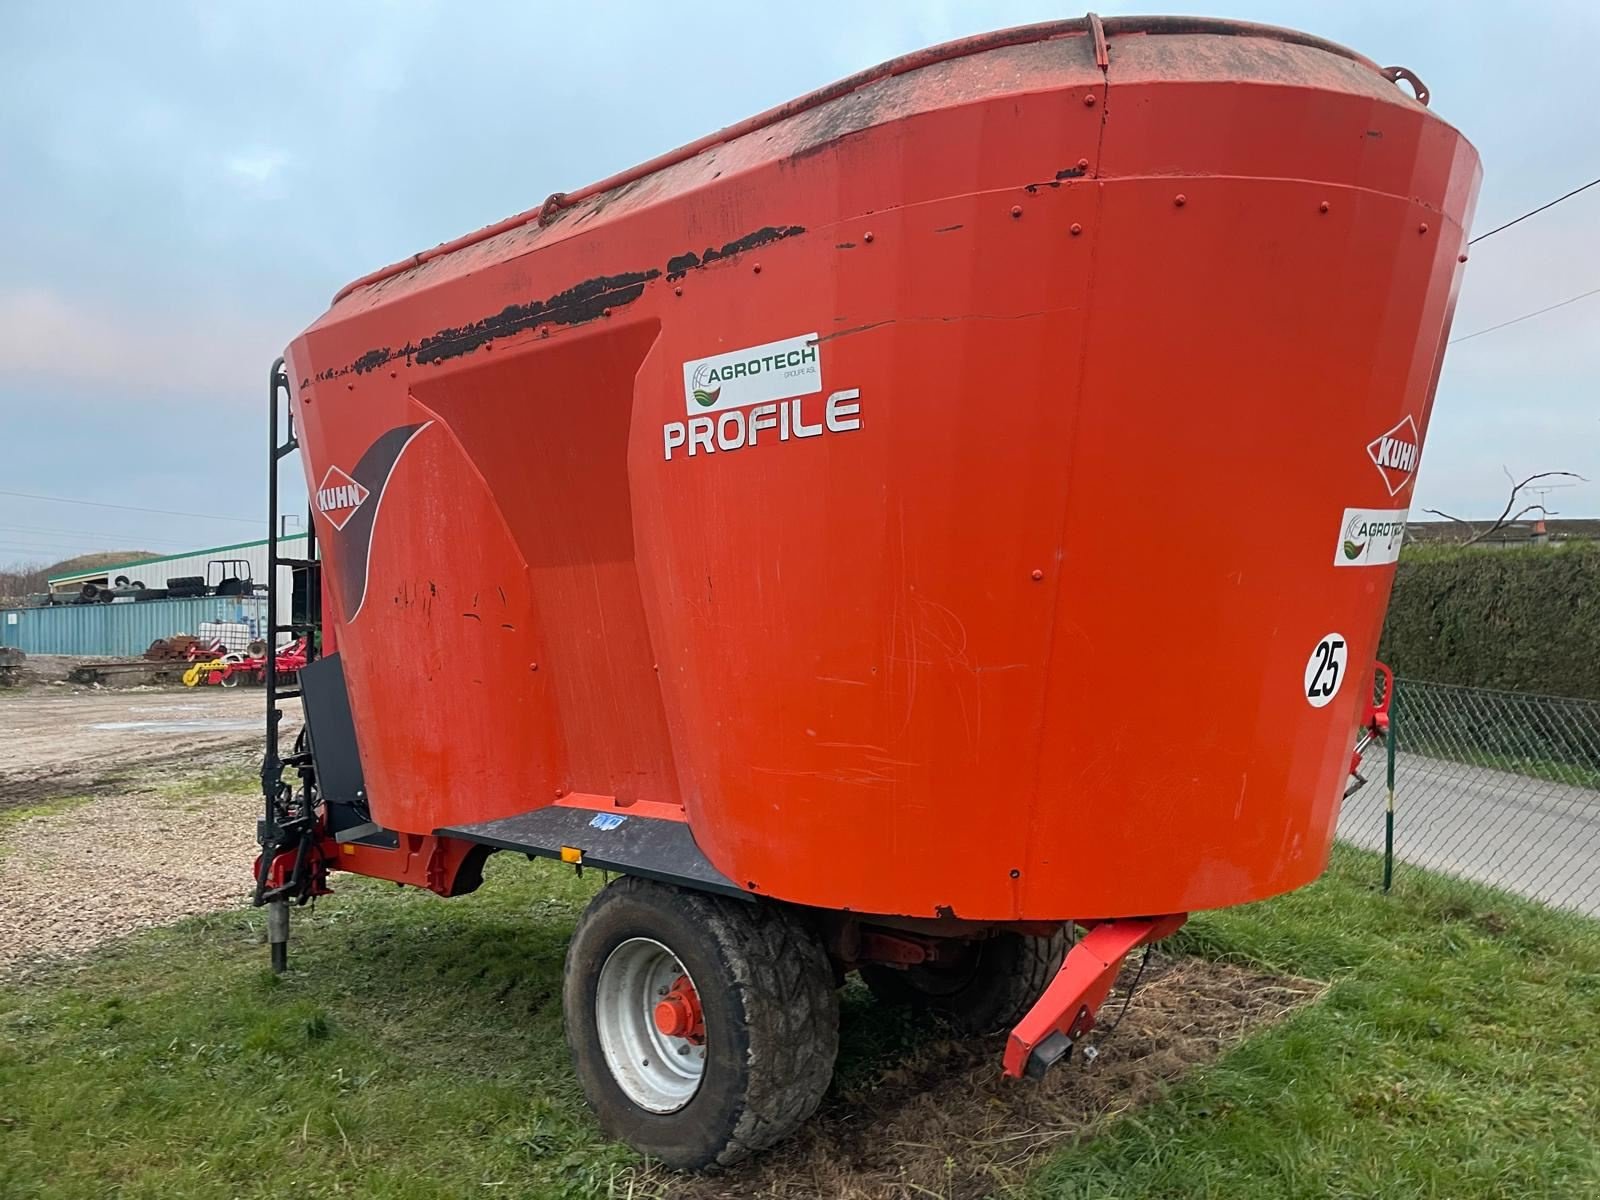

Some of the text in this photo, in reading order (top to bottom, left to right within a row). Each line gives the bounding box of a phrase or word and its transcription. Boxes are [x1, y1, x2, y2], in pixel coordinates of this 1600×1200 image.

[708, 347, 816, 384] AGROTECH
[663, 388, 861, 461] PROFILE
[319, 483, 361, 512] KUHN
[1308, 640, 1345, 697] 25
